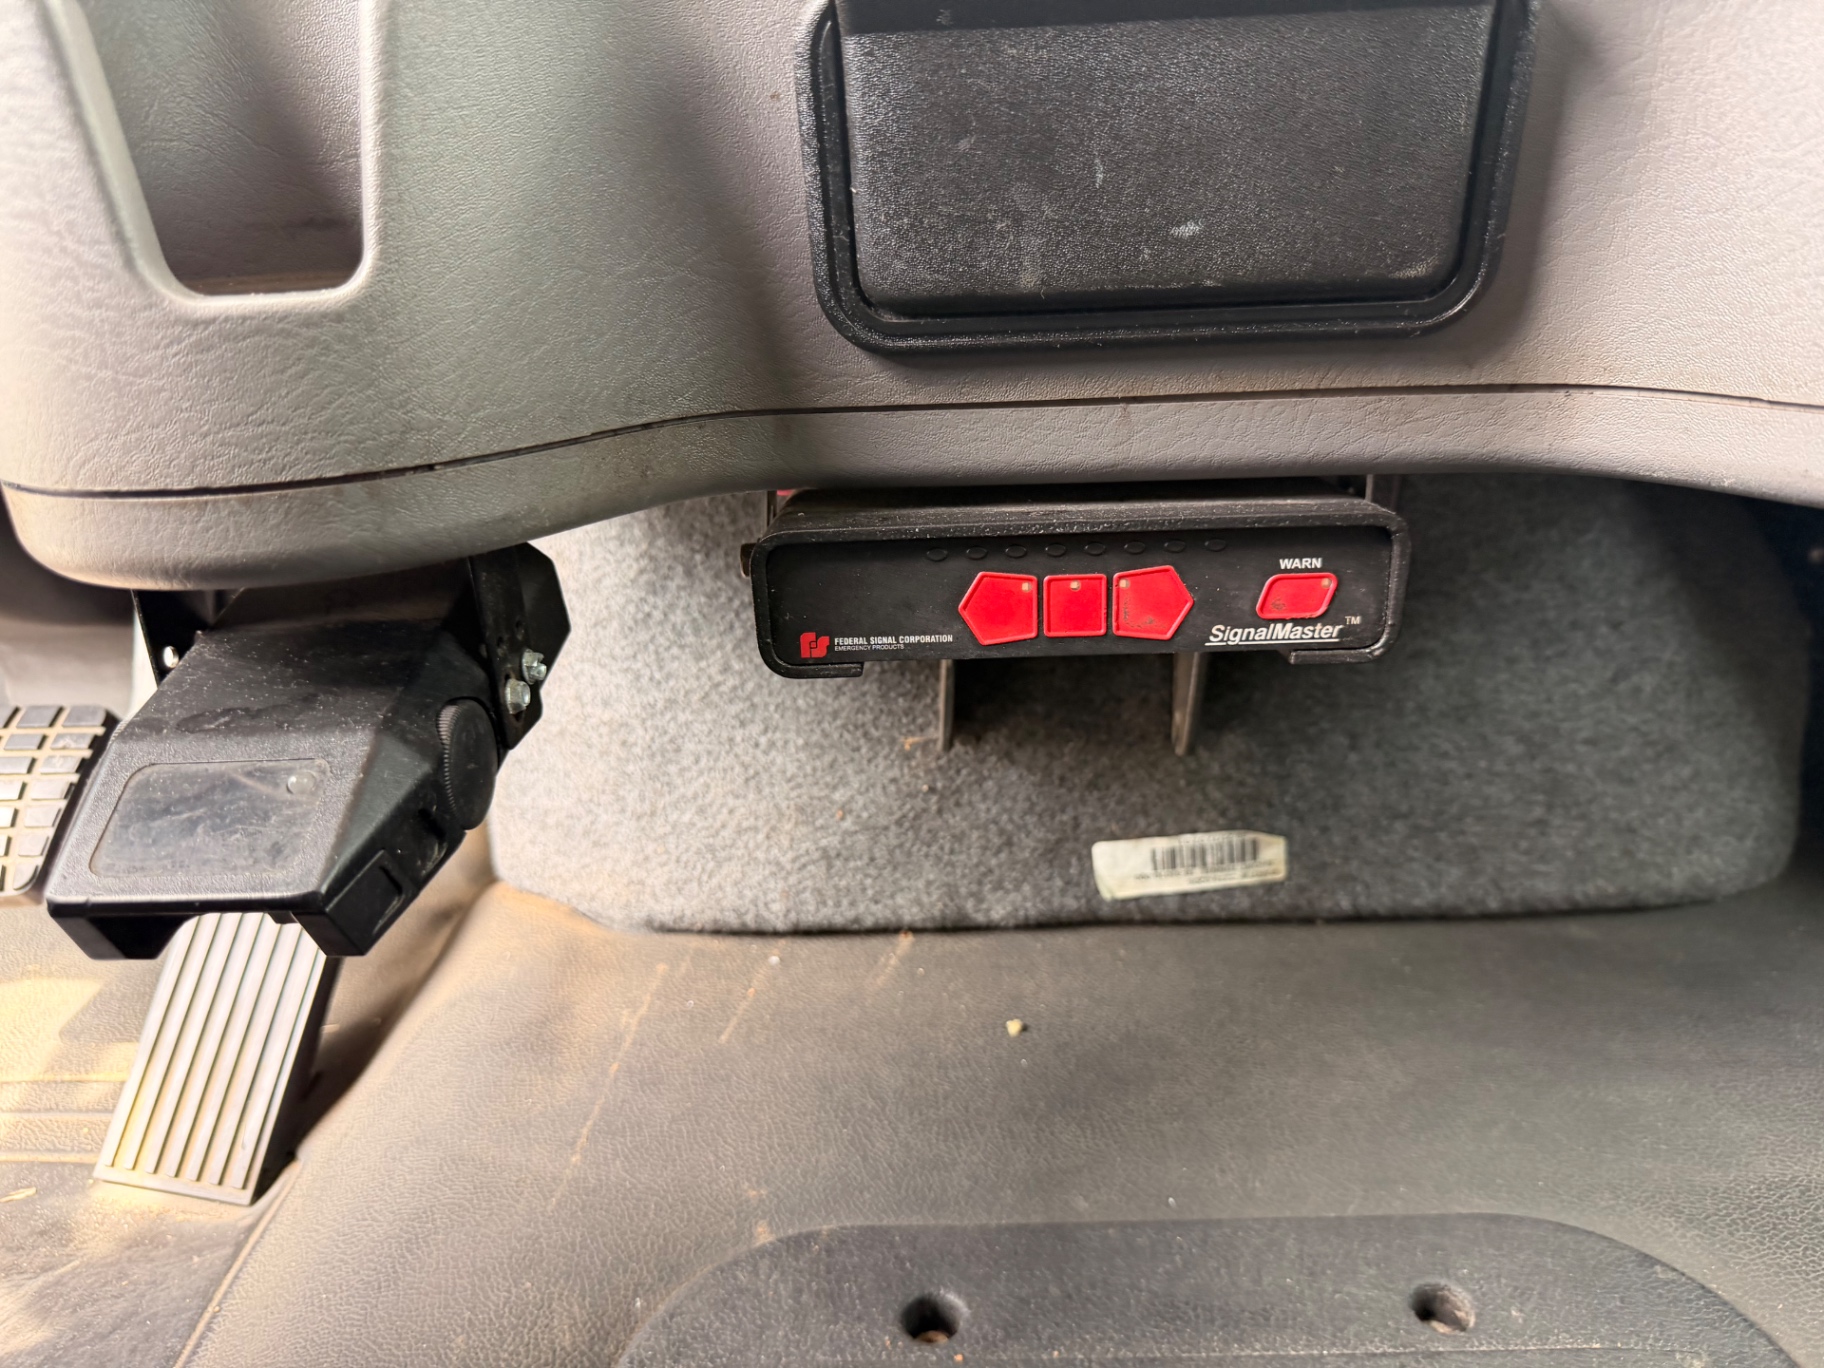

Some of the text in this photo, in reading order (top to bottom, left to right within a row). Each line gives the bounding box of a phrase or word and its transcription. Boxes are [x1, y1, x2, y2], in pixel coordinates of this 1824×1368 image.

[1279, 557, 1323, 570] WARN
[1207, 615, 1362, 645] SignalMaster TM
[834, 634, 953, 645] FEDERAL SIGNAL CORPORATION
